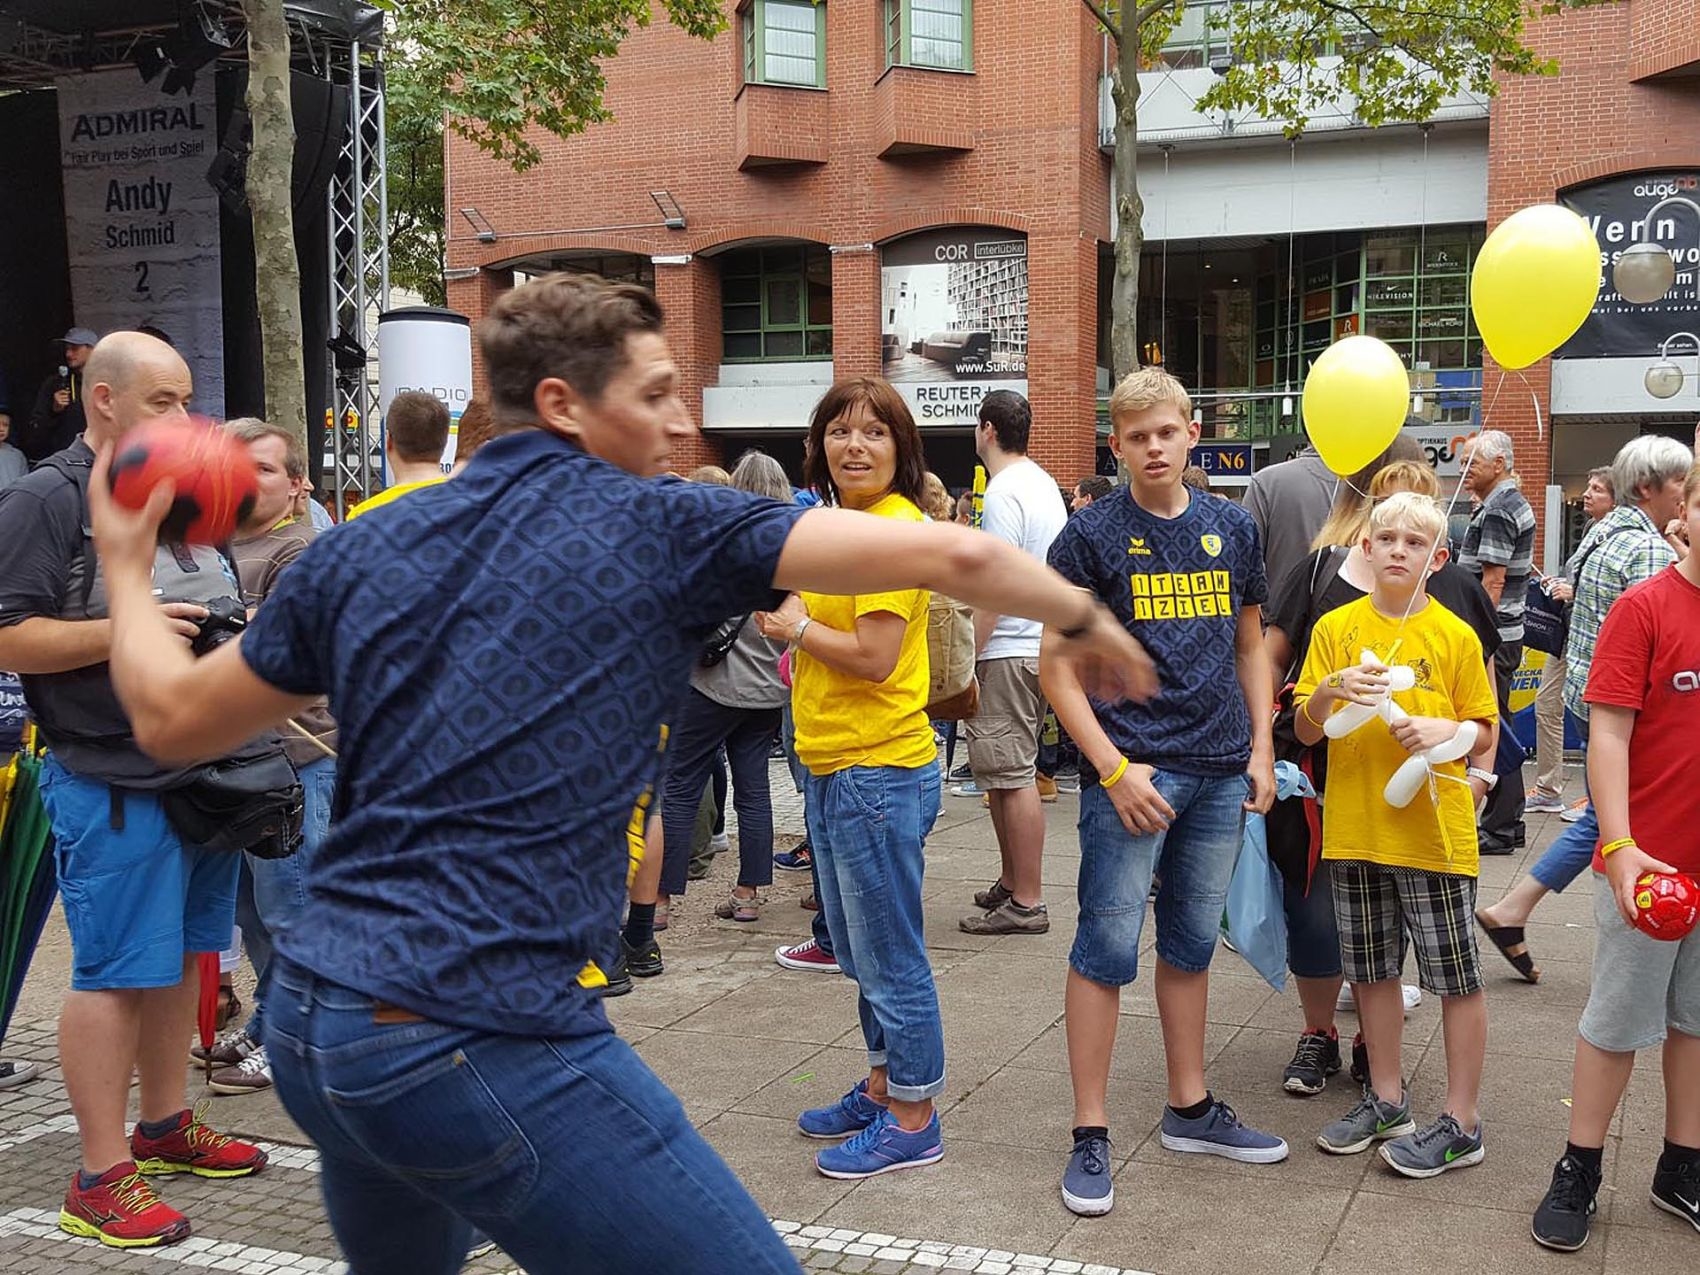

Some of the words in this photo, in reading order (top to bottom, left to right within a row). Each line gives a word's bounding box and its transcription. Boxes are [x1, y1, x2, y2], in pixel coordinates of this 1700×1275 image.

[71, 102, 205, 142] ADMIRAL
[92, 150, 111, 163] Play
[113, 149, 129, 161] bei
[131, 146, 157, 161] Sport
[159, 144, 177, 156] und
[180, 139, 205, 154] Spiel
[105, 176, 172, 216] Andy
[106, 221, 175, 249] Schmid
[935, 244, 968, 261] COR
[976, 242, 1024, 256] interlübke
[134, 261, 150, 293] 2
[956, 360, 1026, 374] www.SuR.de
[1218, 451, 1246, 470] N6
[1128, 548, 1152, 556] erima
[1511, 668, 1542, 677] NECKA
[1510, 677, 1541, 690] WEN
